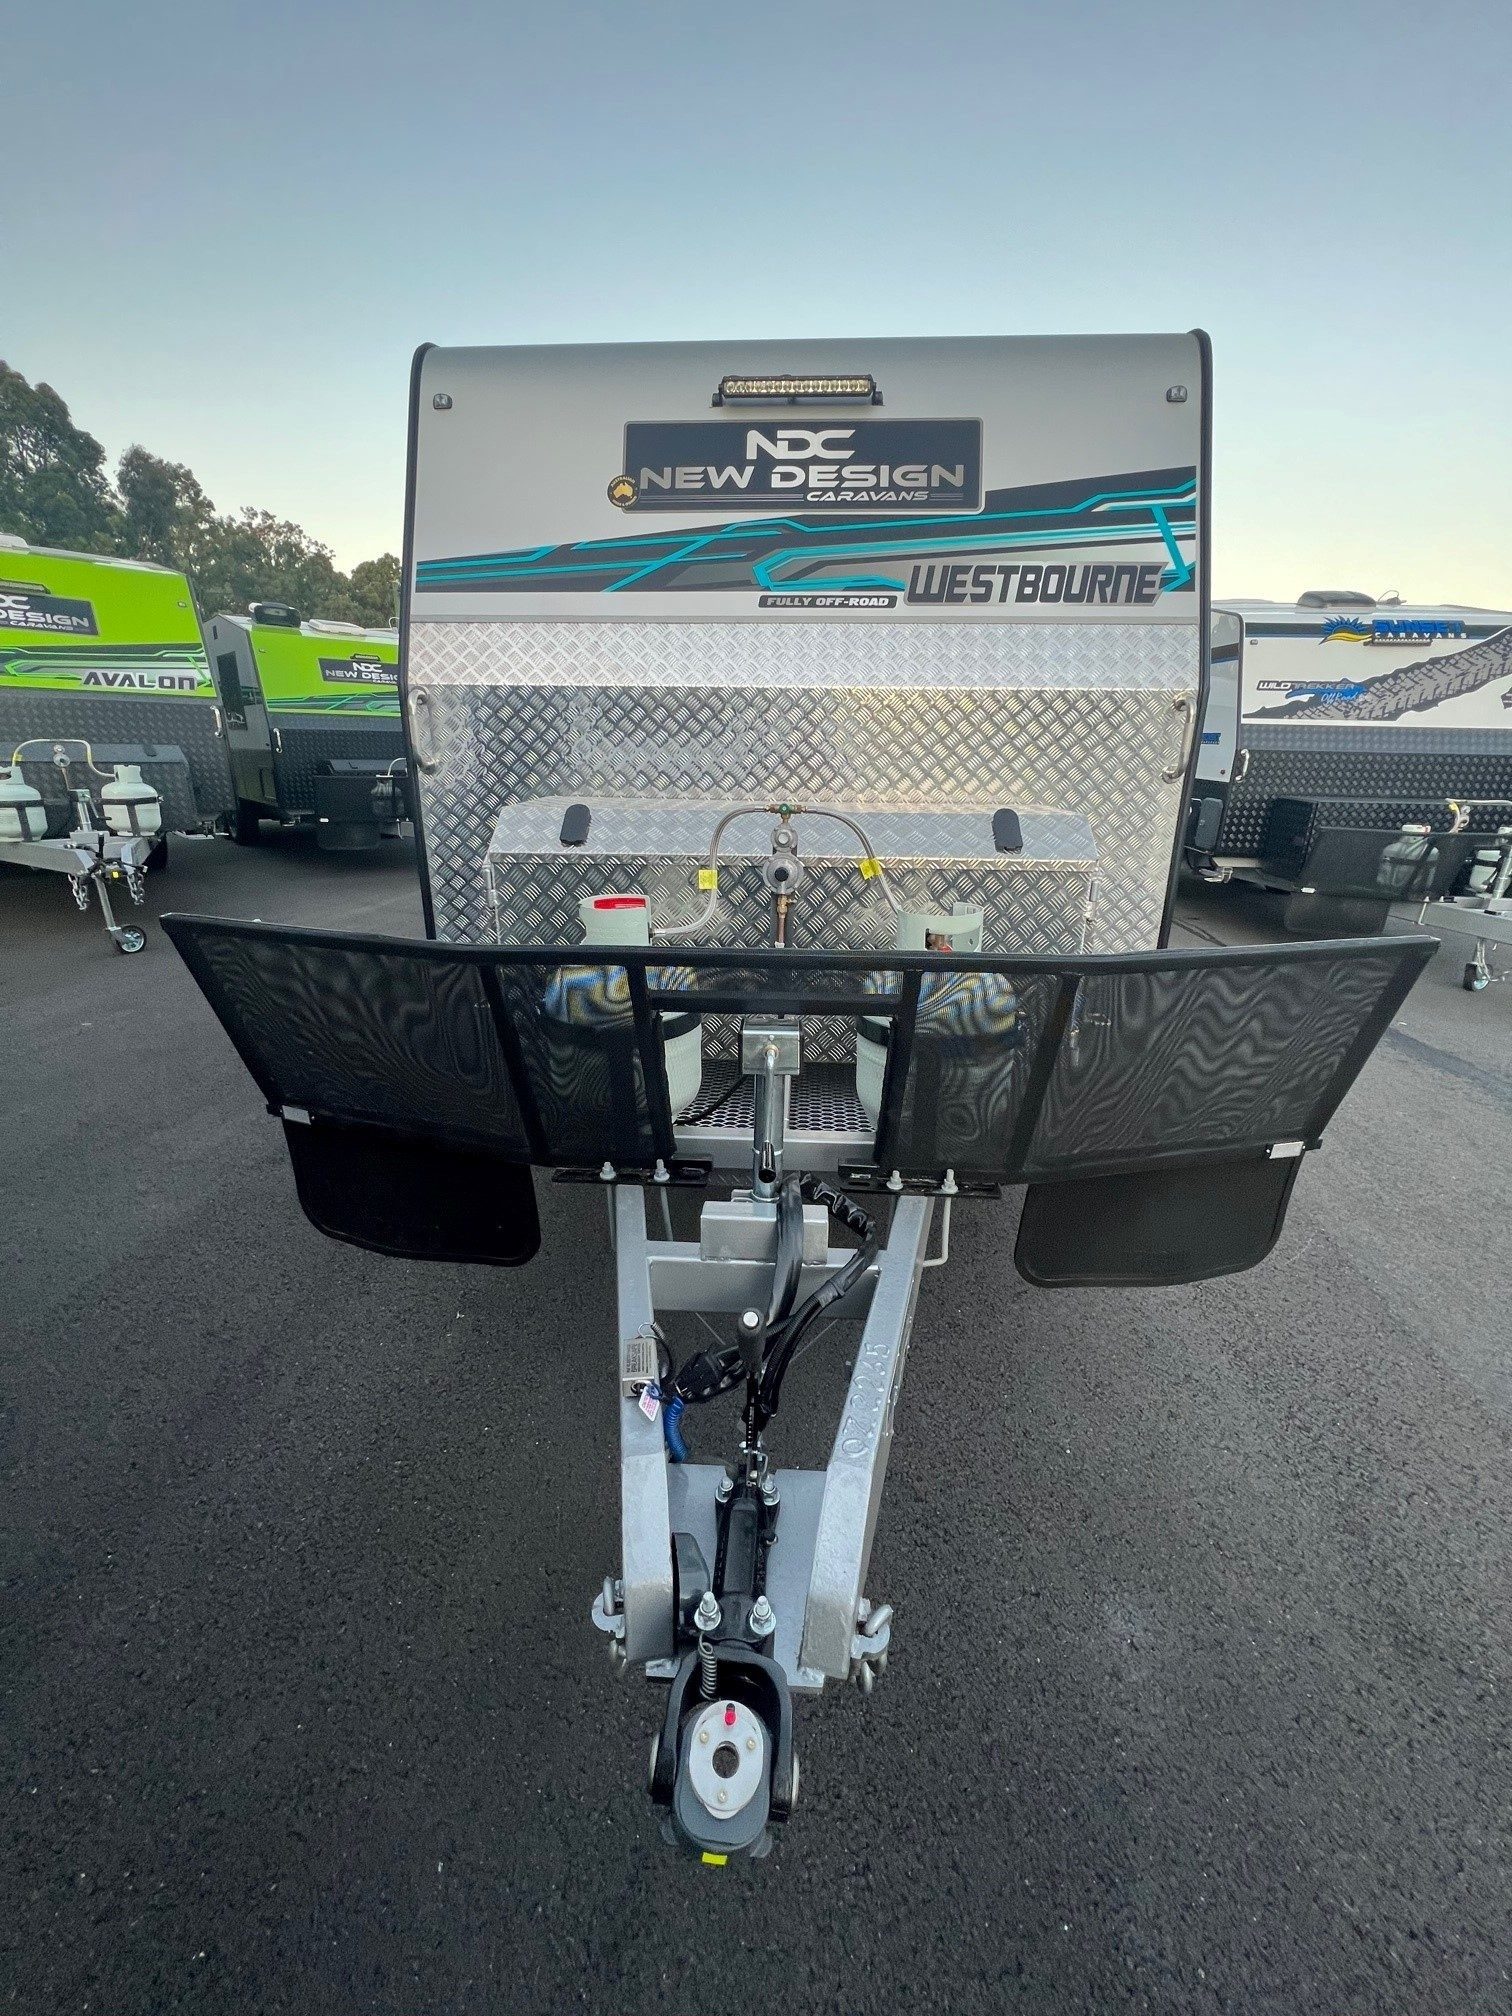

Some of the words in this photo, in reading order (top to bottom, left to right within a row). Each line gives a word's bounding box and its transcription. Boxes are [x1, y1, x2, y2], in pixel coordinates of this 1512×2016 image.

[746, 429, 856, 460] NDC
[640, 466, 755, 490] NEW
[771, 464, 965, 489] DESIGN
[806, 491, 930, 502] CARAVANS
[907, 565, 1163, 604] WESTBOURNE
[766, 597, 811, 607] FULLY
[815, 597, 889, 607] OFF-ROAD
[9, 620, 74, 631] CARAVANS
[352, 662, 383, 673] NDC
[325, 669, 358, 678] NEW
